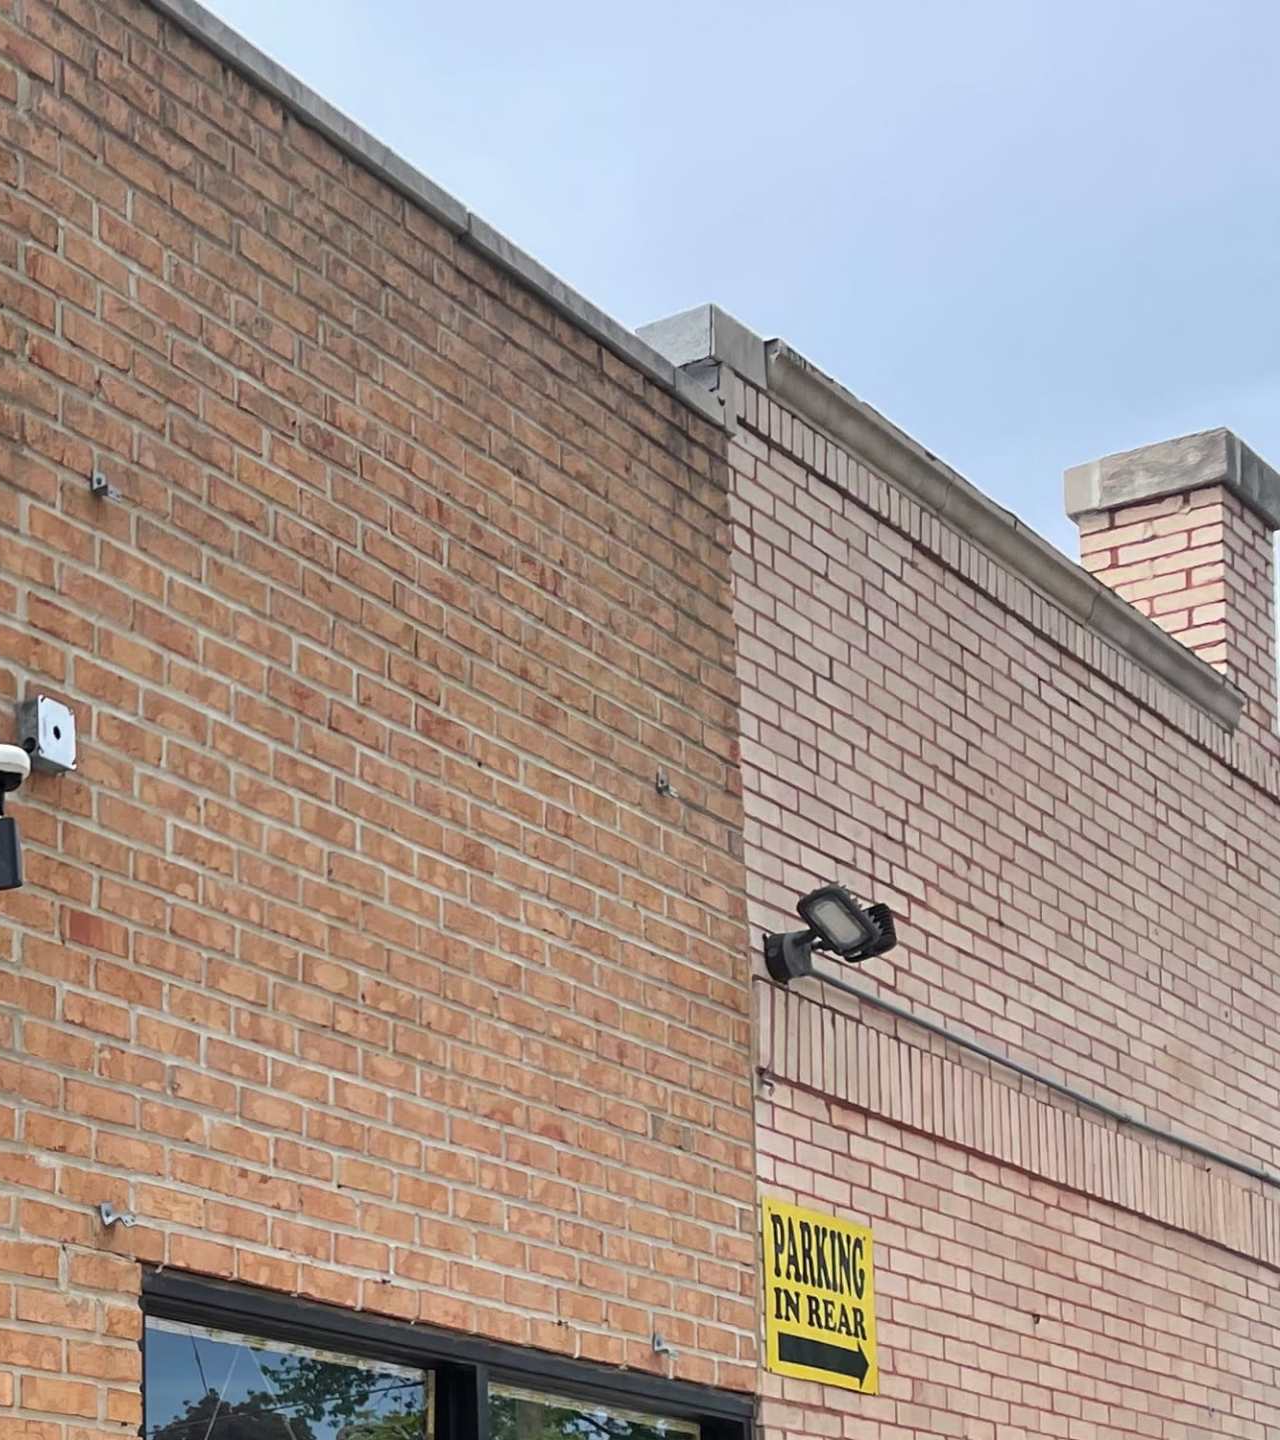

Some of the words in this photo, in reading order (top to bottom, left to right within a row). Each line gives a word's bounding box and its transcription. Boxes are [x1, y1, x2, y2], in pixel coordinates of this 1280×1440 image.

[771, 1214, 865, 1300] PARKING
[773, 1287, 801, 1323] IN
[807, 1295, 867, 1340] REAR
